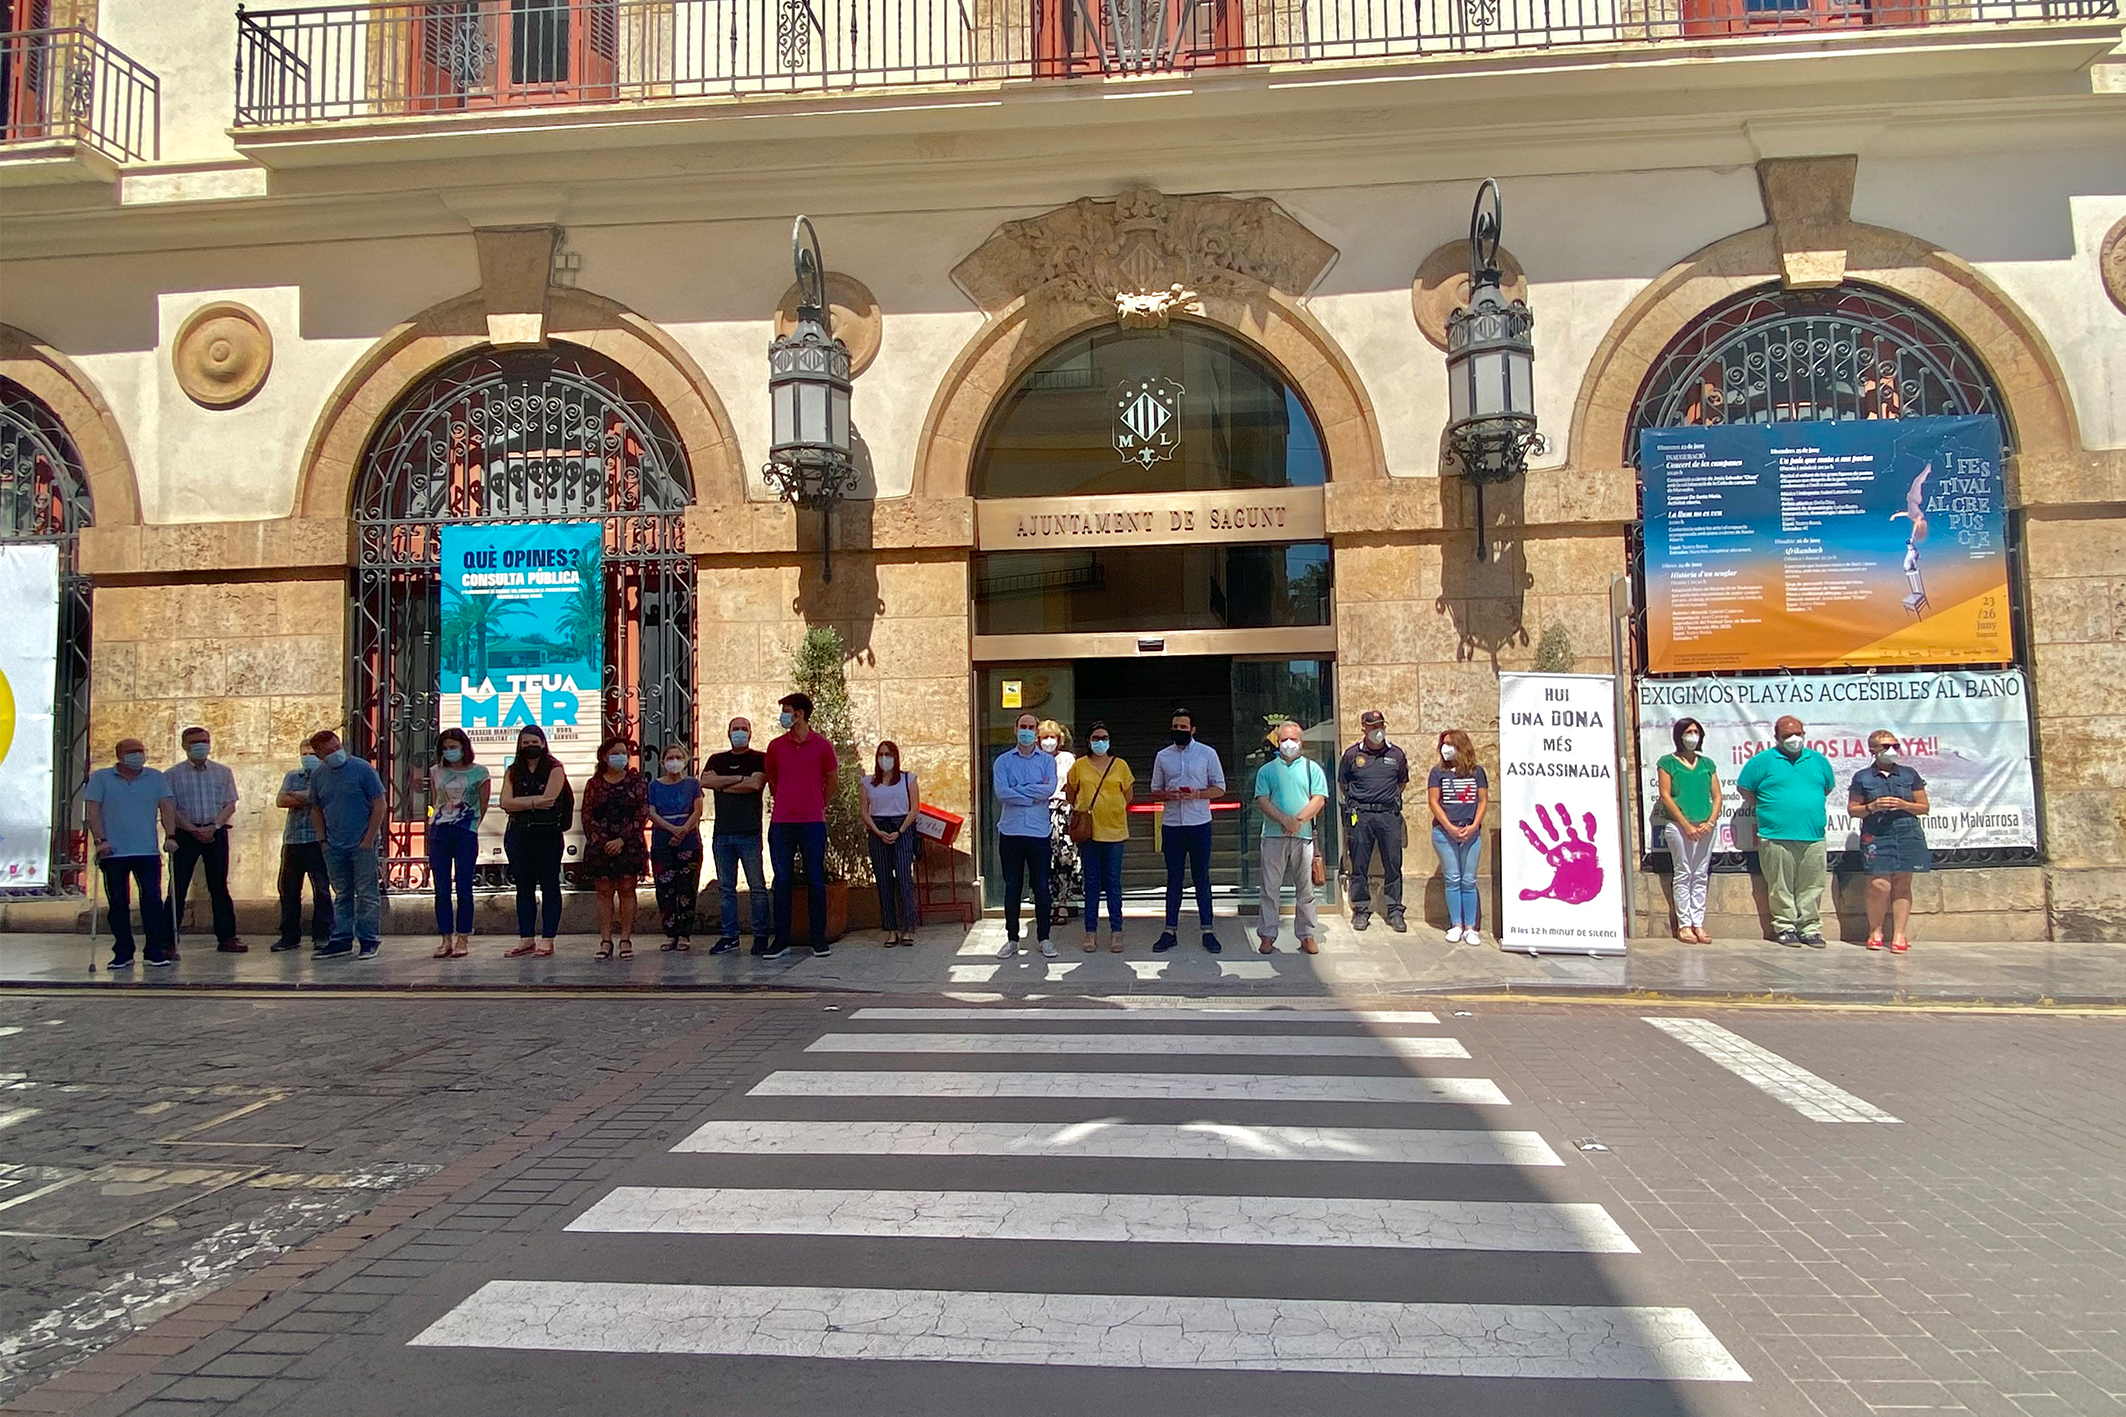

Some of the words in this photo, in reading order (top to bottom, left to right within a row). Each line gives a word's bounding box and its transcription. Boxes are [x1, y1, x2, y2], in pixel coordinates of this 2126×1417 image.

[1118, 434, 1134, 448] M
[1160, 432, 1173, 445] L
[1945, 452, 1953, 468] I
[1957, 458, 1990, 477] FES
[1940, 477, 1991, 496] TIVAL
[1926, 496, 1950, 512] AL
[1952, 497, 1991, 514] CRE
[1016, 511, 1154, 537] AJUNTAMENT
[1170, 510, 1195, 532] DE
[1210, 506, 1287, 530] SAGUNT
[1949, 512, 1984, 530] PUS
[464, 544, 497, 568] QUÈ
[503, 548, 580, 568] OPINES?
[462, 572, 524, 587] CONSULTA
[528, 568, 580, 585] PÚBLICA
[1983, 597, 1995, 606] 23
[1978, 608, 1996, 619] /26
[461, 676, 497, 694] LA
[506, 674, 580, 692] TEUA
[1640, 685, 1734, 705] EXIGIMOS
[1738, 684, 1813, 704] PLAYAS
[1819, 680, 1930, 702] ACCESIBLES
[1936, 678, 1960, 699] AL
[1965, 674, 2020, 698] BAÑO
[1545, 688, 1569, 702] HUI
[462, 692, 578, 728] MAR
[1511, 712, 1544, 726] UNA
[1552, 710, 1603, 728] DONA
[1543, 736, 1572, 752] MÉS
[1844, 739, 1866, 758] LA
[1506, 762, 1610, 778] ASSASSINADA
[1952, 816, 1958, 832] y
[1960, 812, 2019, 829] Malvarrosa
